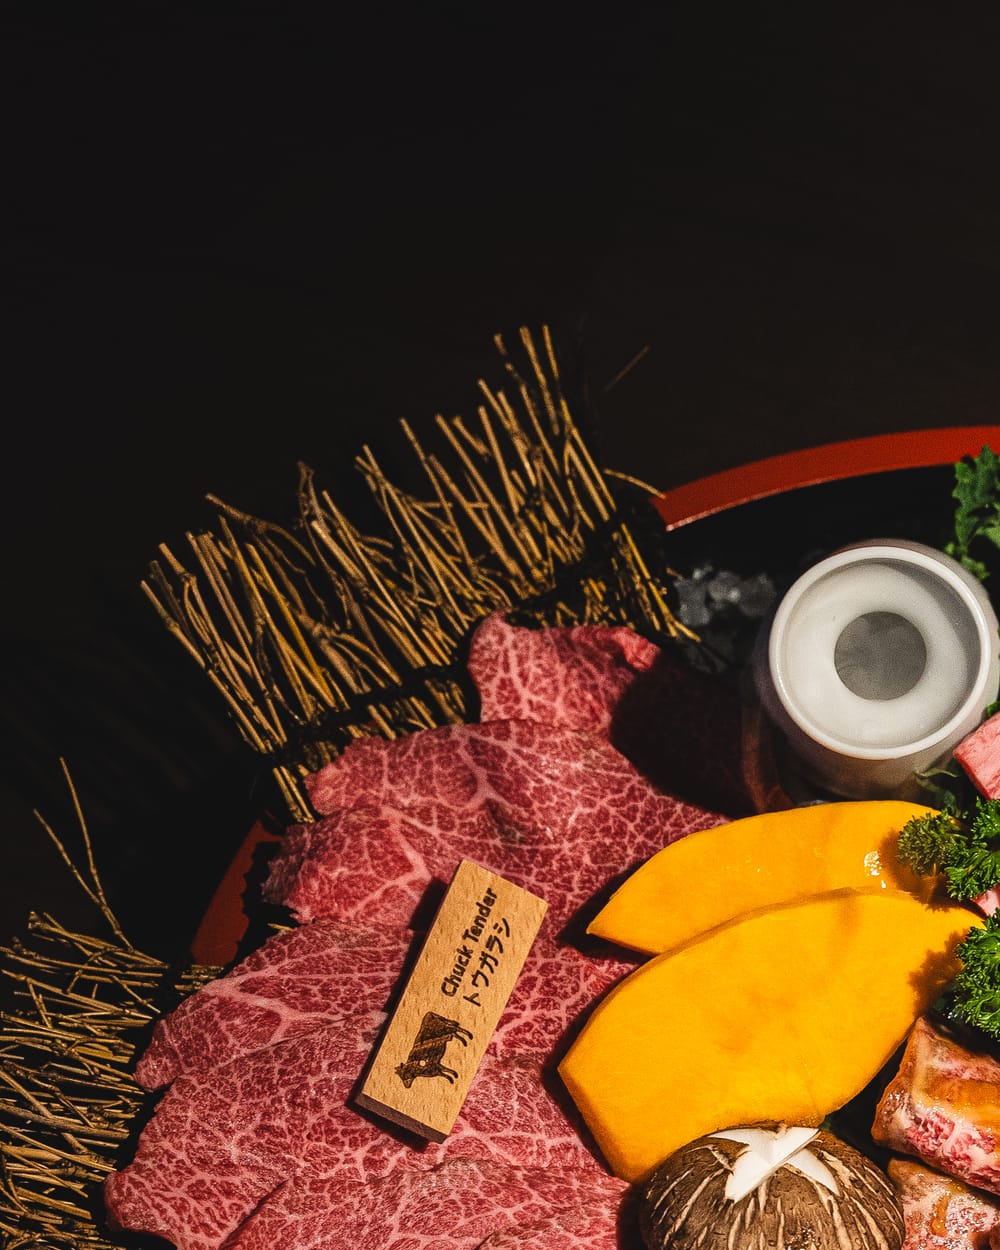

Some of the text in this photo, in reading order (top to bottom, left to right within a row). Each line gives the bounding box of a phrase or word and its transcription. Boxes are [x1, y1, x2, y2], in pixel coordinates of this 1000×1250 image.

[441, 887, 498, 997] Chuck Tender
[463, 917, 510, 1007] トウガラシ
